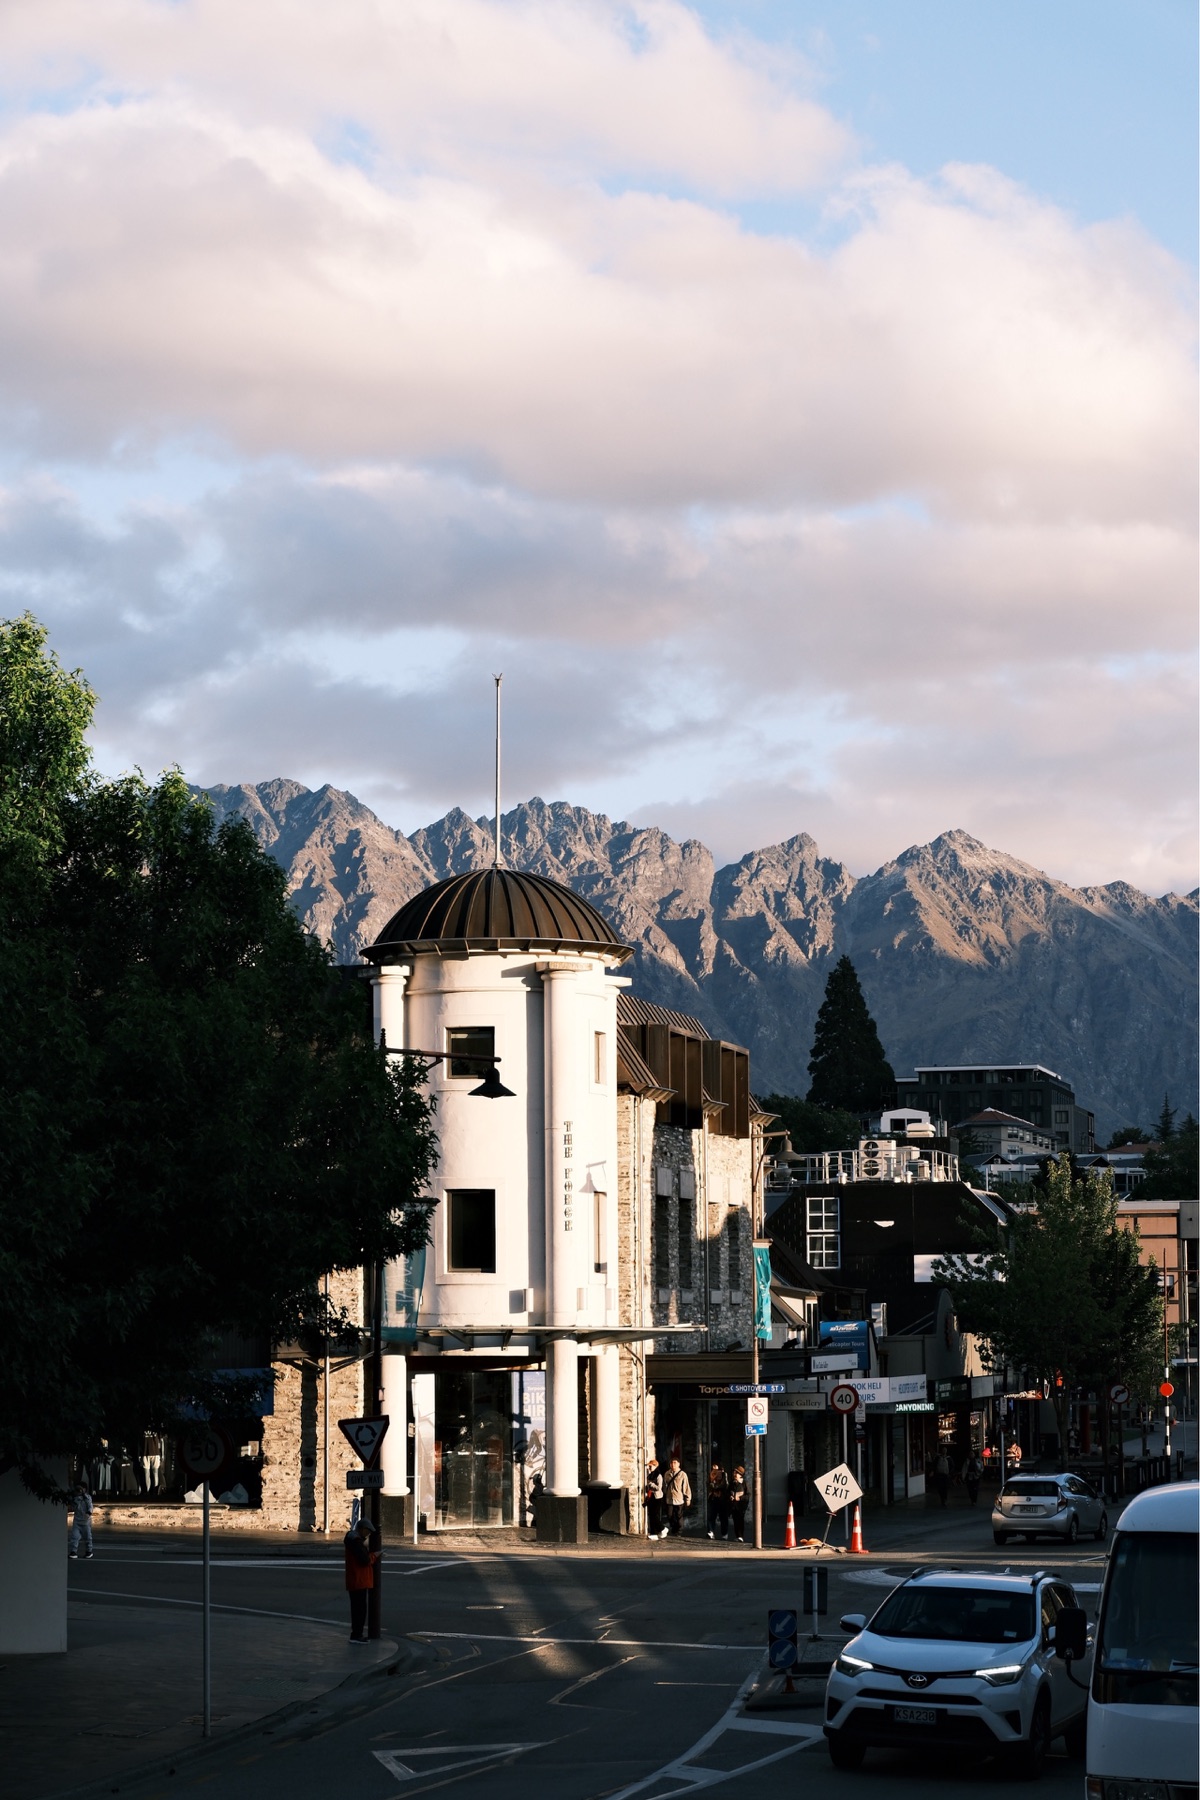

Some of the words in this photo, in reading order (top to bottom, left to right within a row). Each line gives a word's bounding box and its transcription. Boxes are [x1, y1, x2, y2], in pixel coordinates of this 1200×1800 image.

[563, 1121, 573, 1158] THE
[699, 1385, 730, 1394] Torpe
[848, 1382, 866, 1391] OOK
[867, 1382, 882, 1390] HELI
[523, 1391, 546, 1404] BIK
[836, 1394, 852, 1405] 40
[858, 1393, 876, 1401] OURS
[771, 1399, 794, 1407] Clarke
[796, 1399, 822, 1408] Gallery
[523, 1404, 546, 1416] HIR
[190, 1440, 218, 1461] 50
[351, 1475, 365, 1485] GIVE
[368, 1474, 381, 1484] WAY
[832, 1472, 848, 1486] NO
[824, 1484, 850, 1500] EXIT
